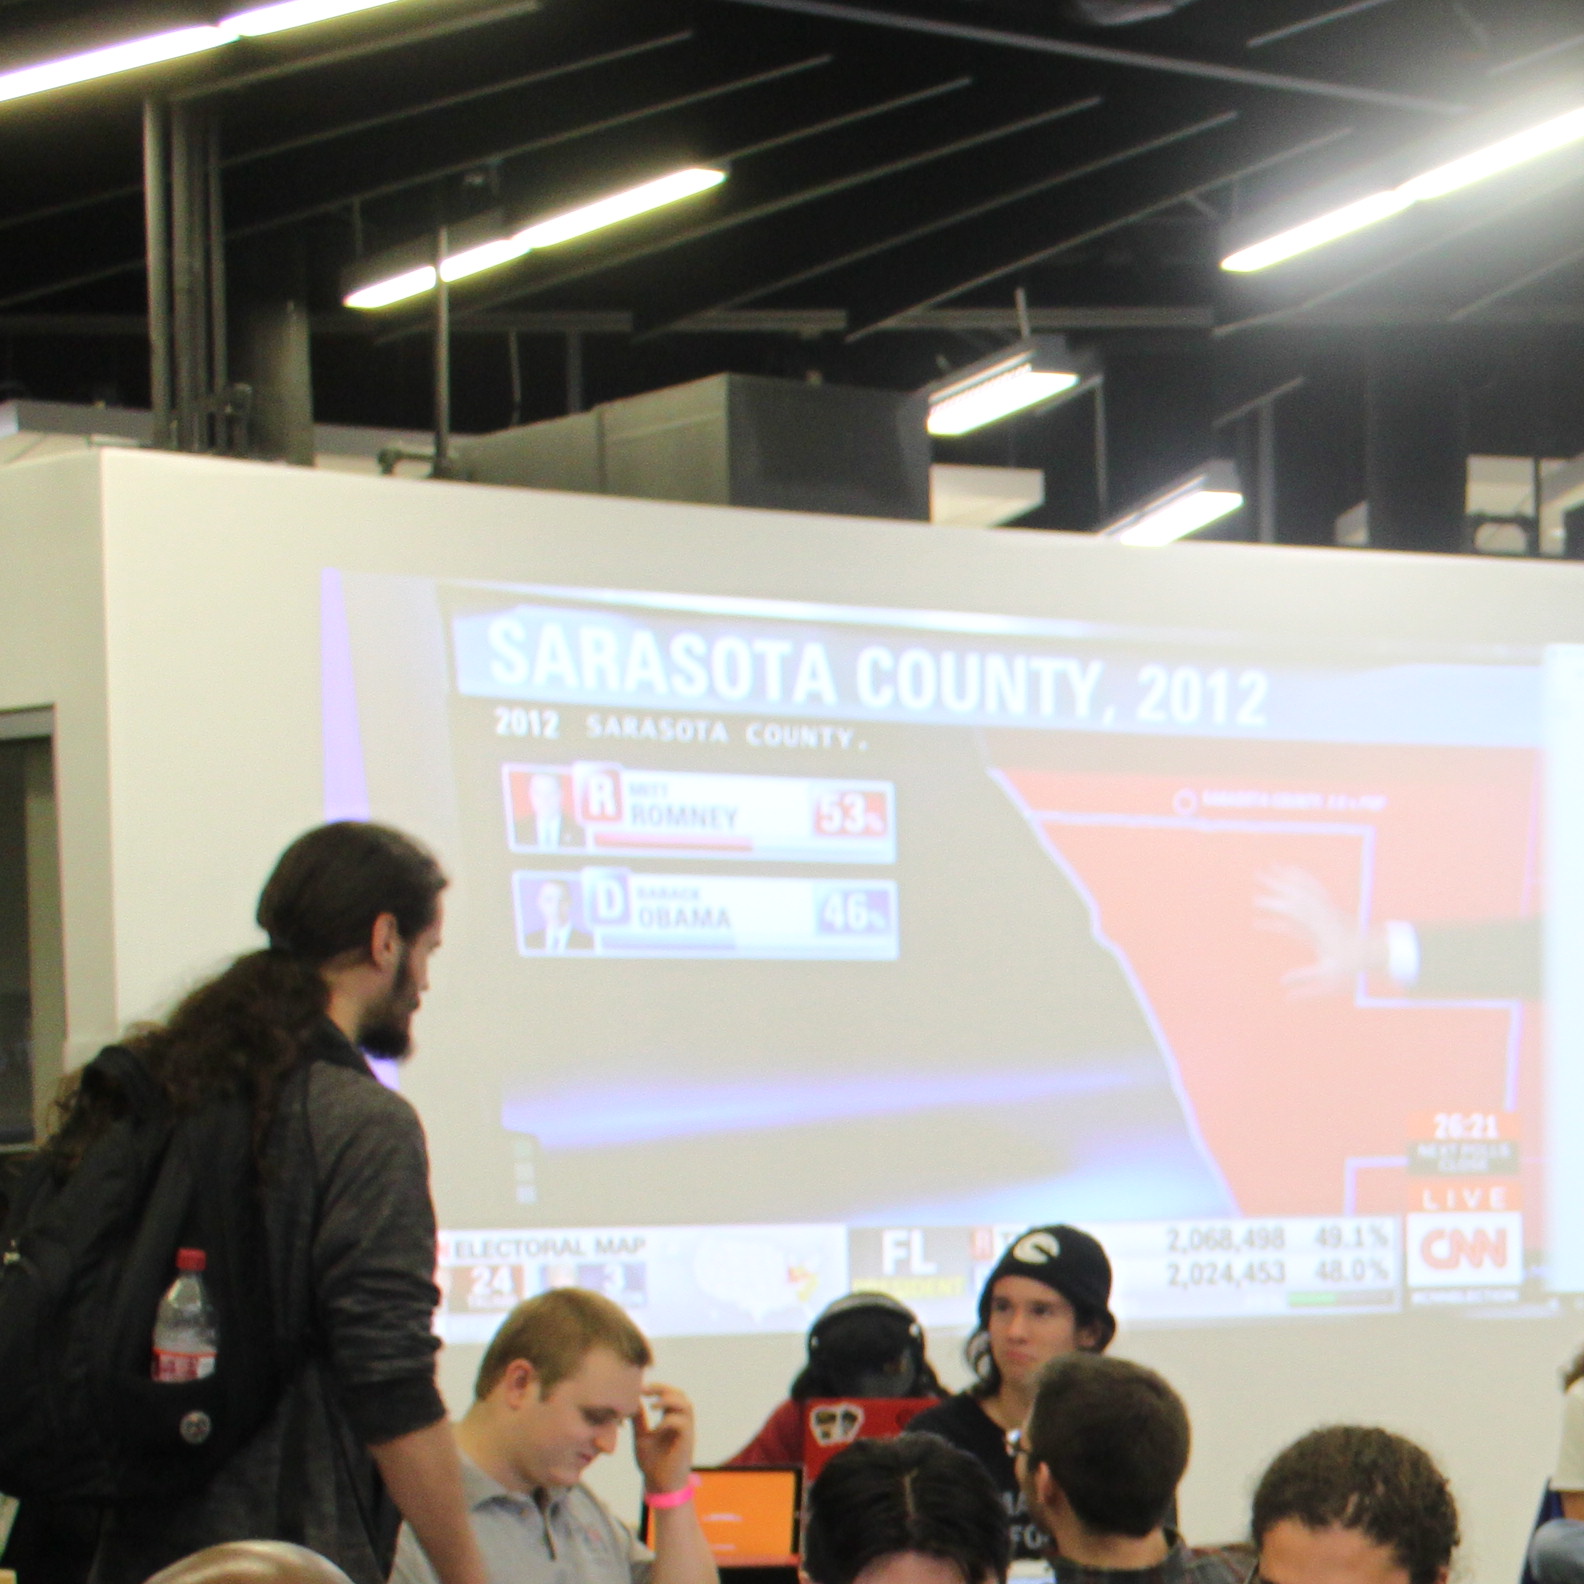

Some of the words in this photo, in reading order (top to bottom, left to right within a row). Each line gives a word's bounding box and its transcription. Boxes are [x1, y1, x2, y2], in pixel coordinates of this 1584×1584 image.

[486, 616, 838, 707] SARASOTA
[856, 645, 1115, 727] COUNTY,
[1136, 662, 1269, 728] 2012
[494, 706, 560, 739] 2012
[586, 713, 730, 744] SARASOTA
[588, 771, 617, 818] R
[631, 802, 739, 830] ROMNEY
[638, 904, 732, 930] OBAMA
[1434, 1112, 1500, 1139] 26:21
[1423, 1186, 1507, 1211] LIVE
[455, 1236, 587, 1260] ELECTORAL
[594, 1235, 646, 1256] MAP
[882, 1228, 938, 1275] FL
[1167, 1225, 1286, 1254] 2,068,498
[1314, 1224, 1390, 1250] 49.1%
[1420, 1227, 1508, 1270] CNN
[472, 1266, 513, 1295] 24
[602, 1264, 626, 1293] 3
[1167, 1259, 1286, 1290] 2,024,453
[1315, 1258, 1390, 1283] 48.0%
